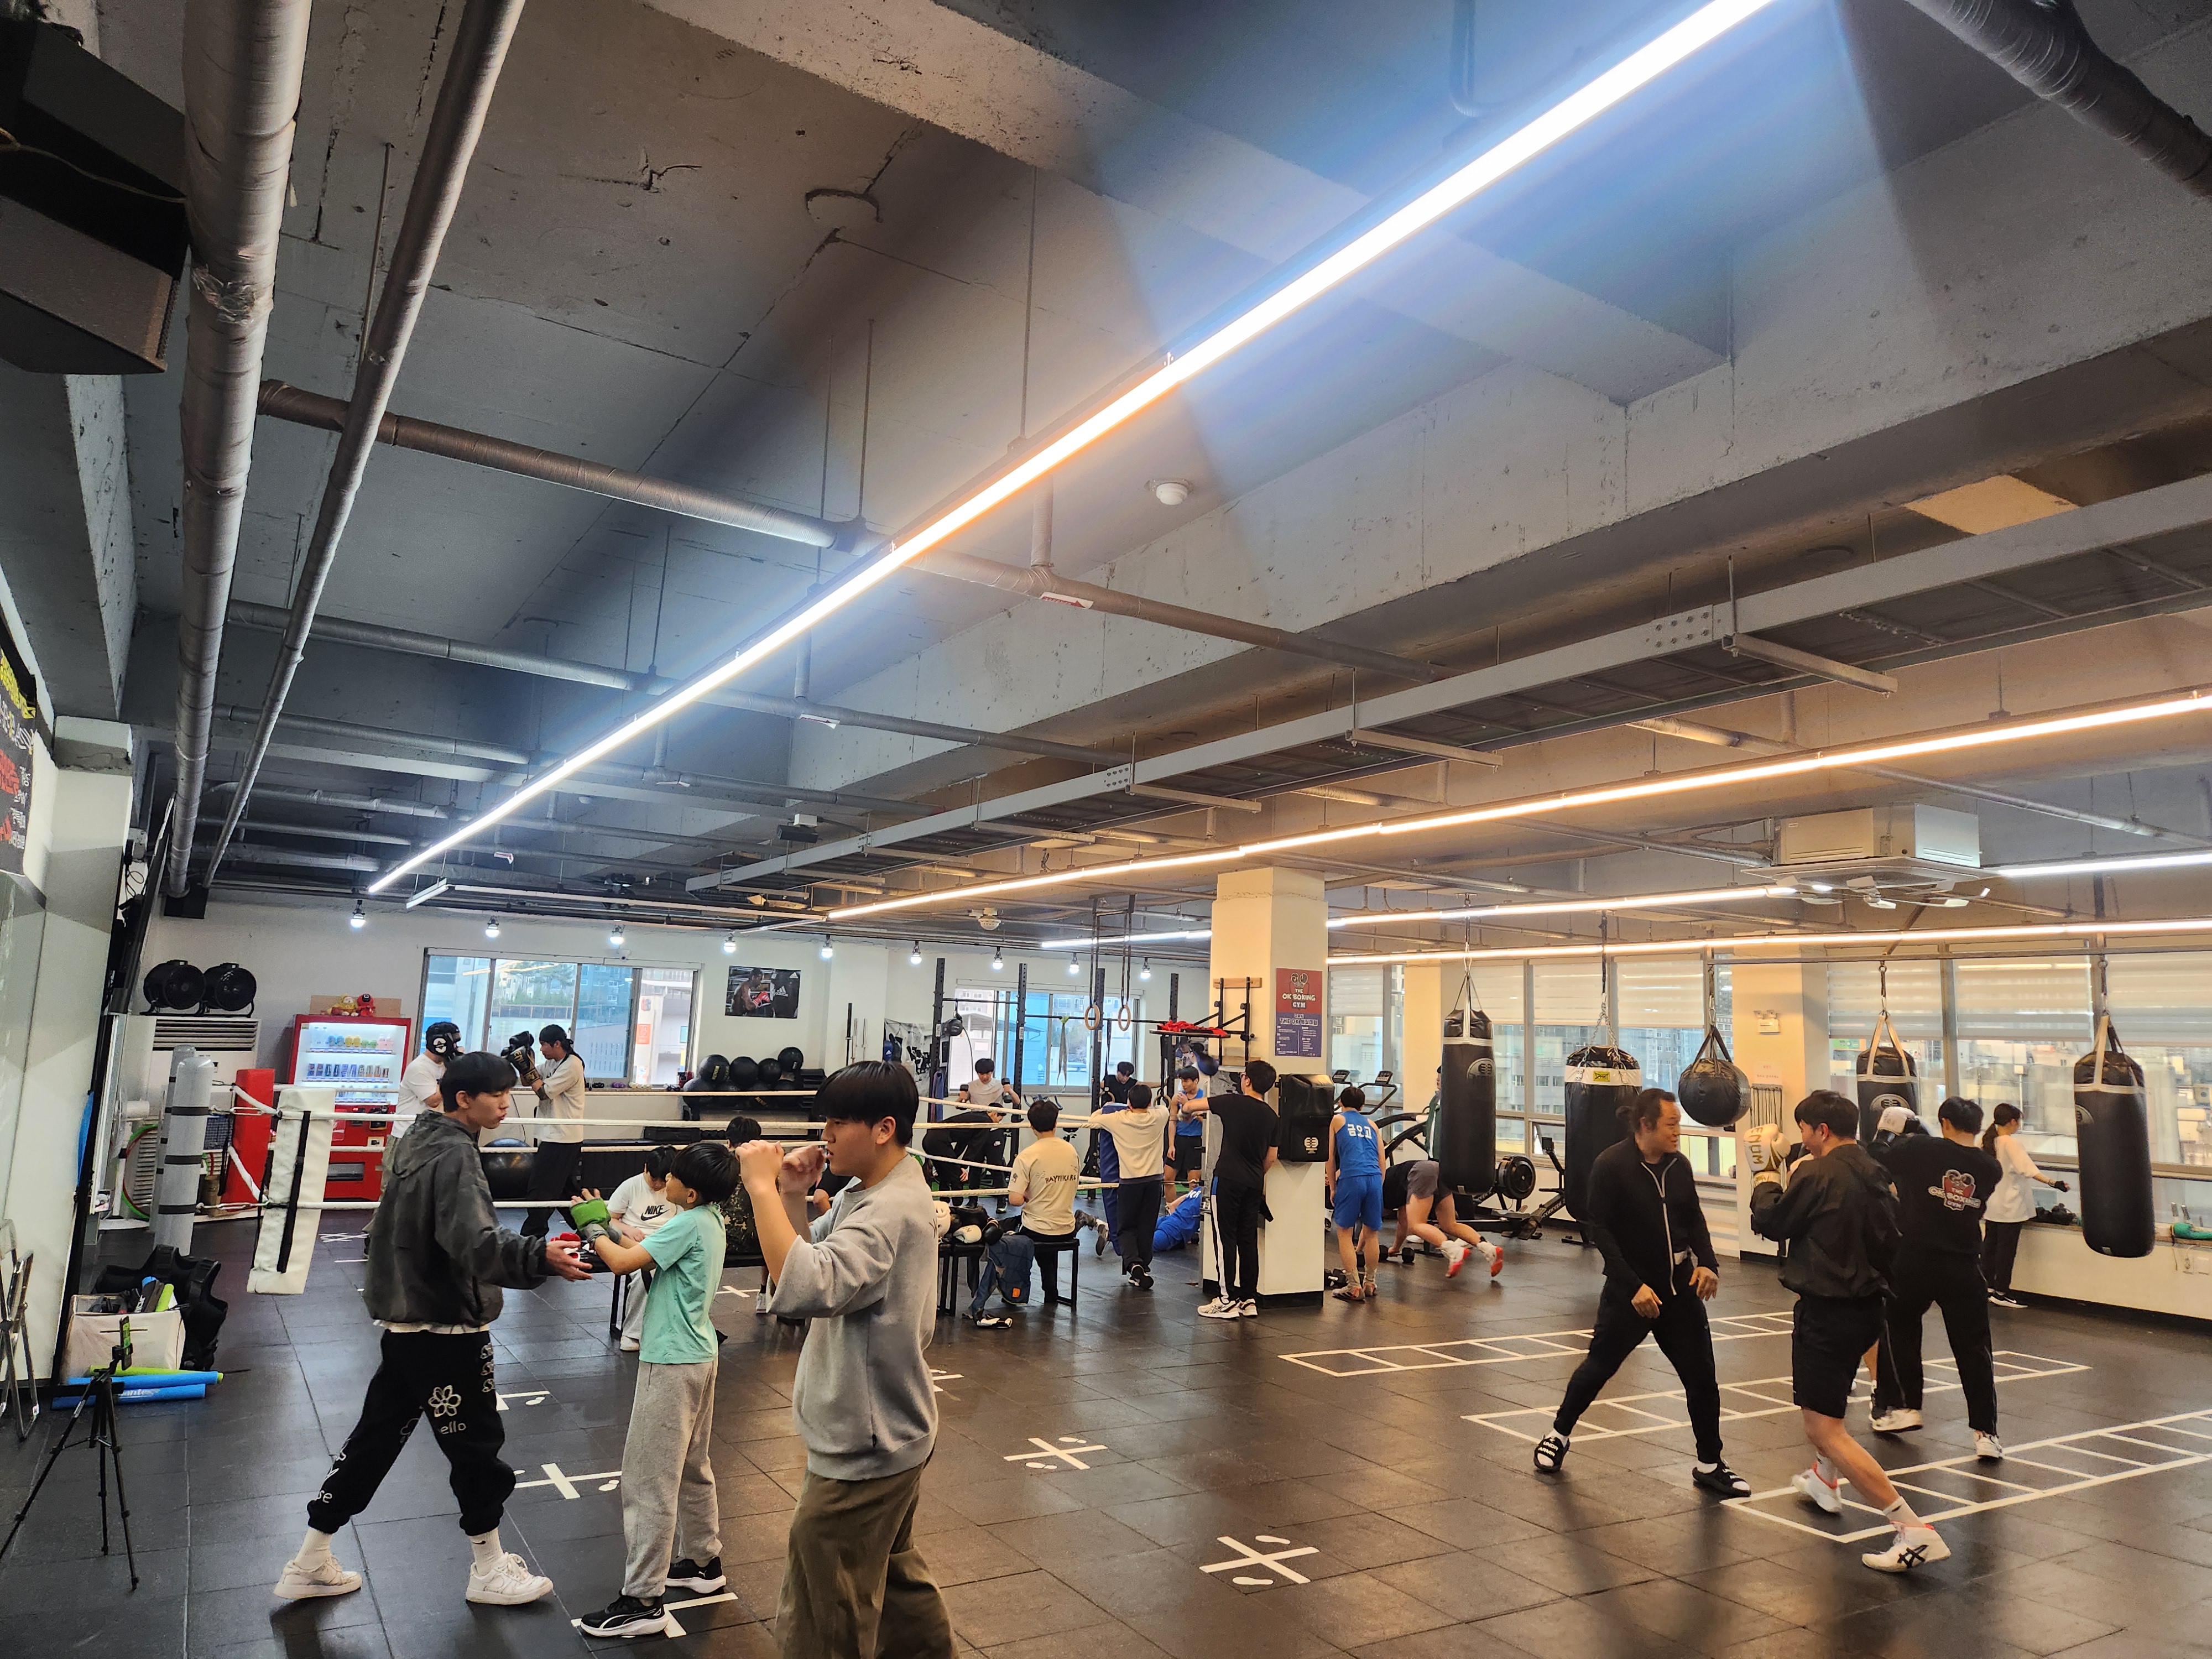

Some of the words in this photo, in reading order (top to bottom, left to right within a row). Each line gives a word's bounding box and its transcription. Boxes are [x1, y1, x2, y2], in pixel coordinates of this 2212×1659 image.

[1347, 1123, 1372, 1139] 금오고
[1748, 1126, 1764, 1164] ENUM
[1929, 1187, 1945, 1198] OK
[1946, 1192, 1980, 1208] BOXING
[644, 1204, 665, 1215] NIKE
[440, 1420, 467, 1434] ello
